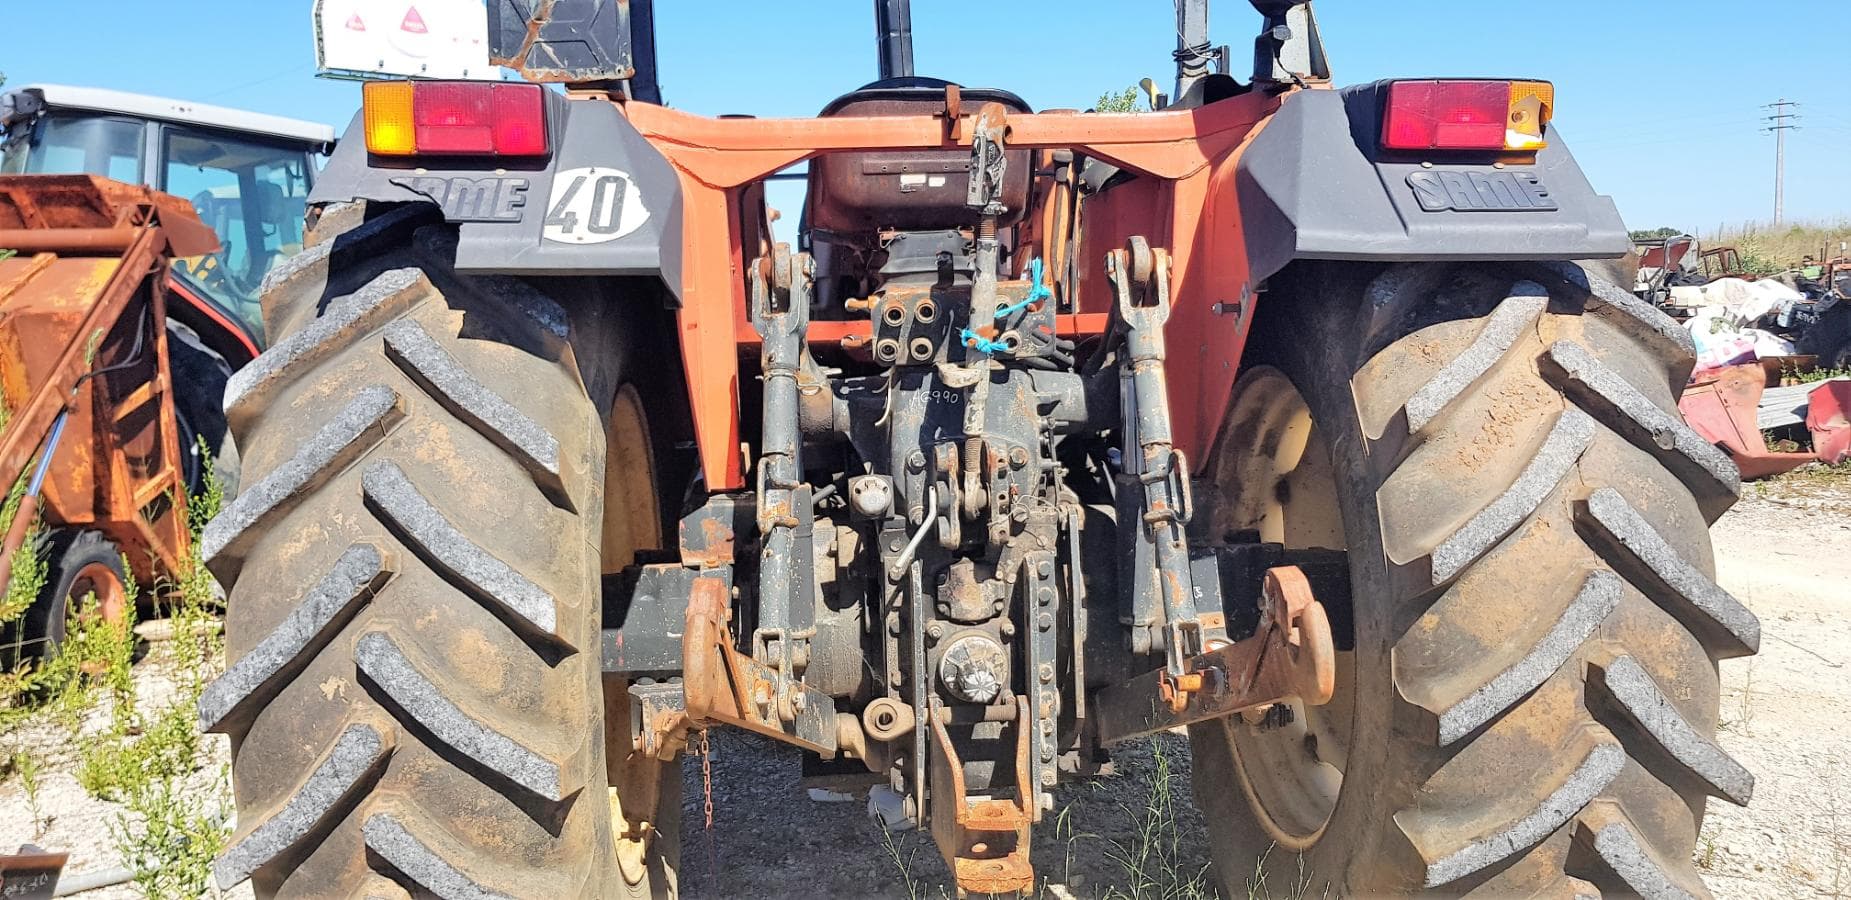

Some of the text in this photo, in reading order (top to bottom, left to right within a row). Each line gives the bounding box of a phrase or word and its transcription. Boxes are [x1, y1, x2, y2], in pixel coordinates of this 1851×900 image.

[389, 177, 530, 222] AME
[546, 175, 627, 234] 40
[1406, 171, 1557, 212] SAME
